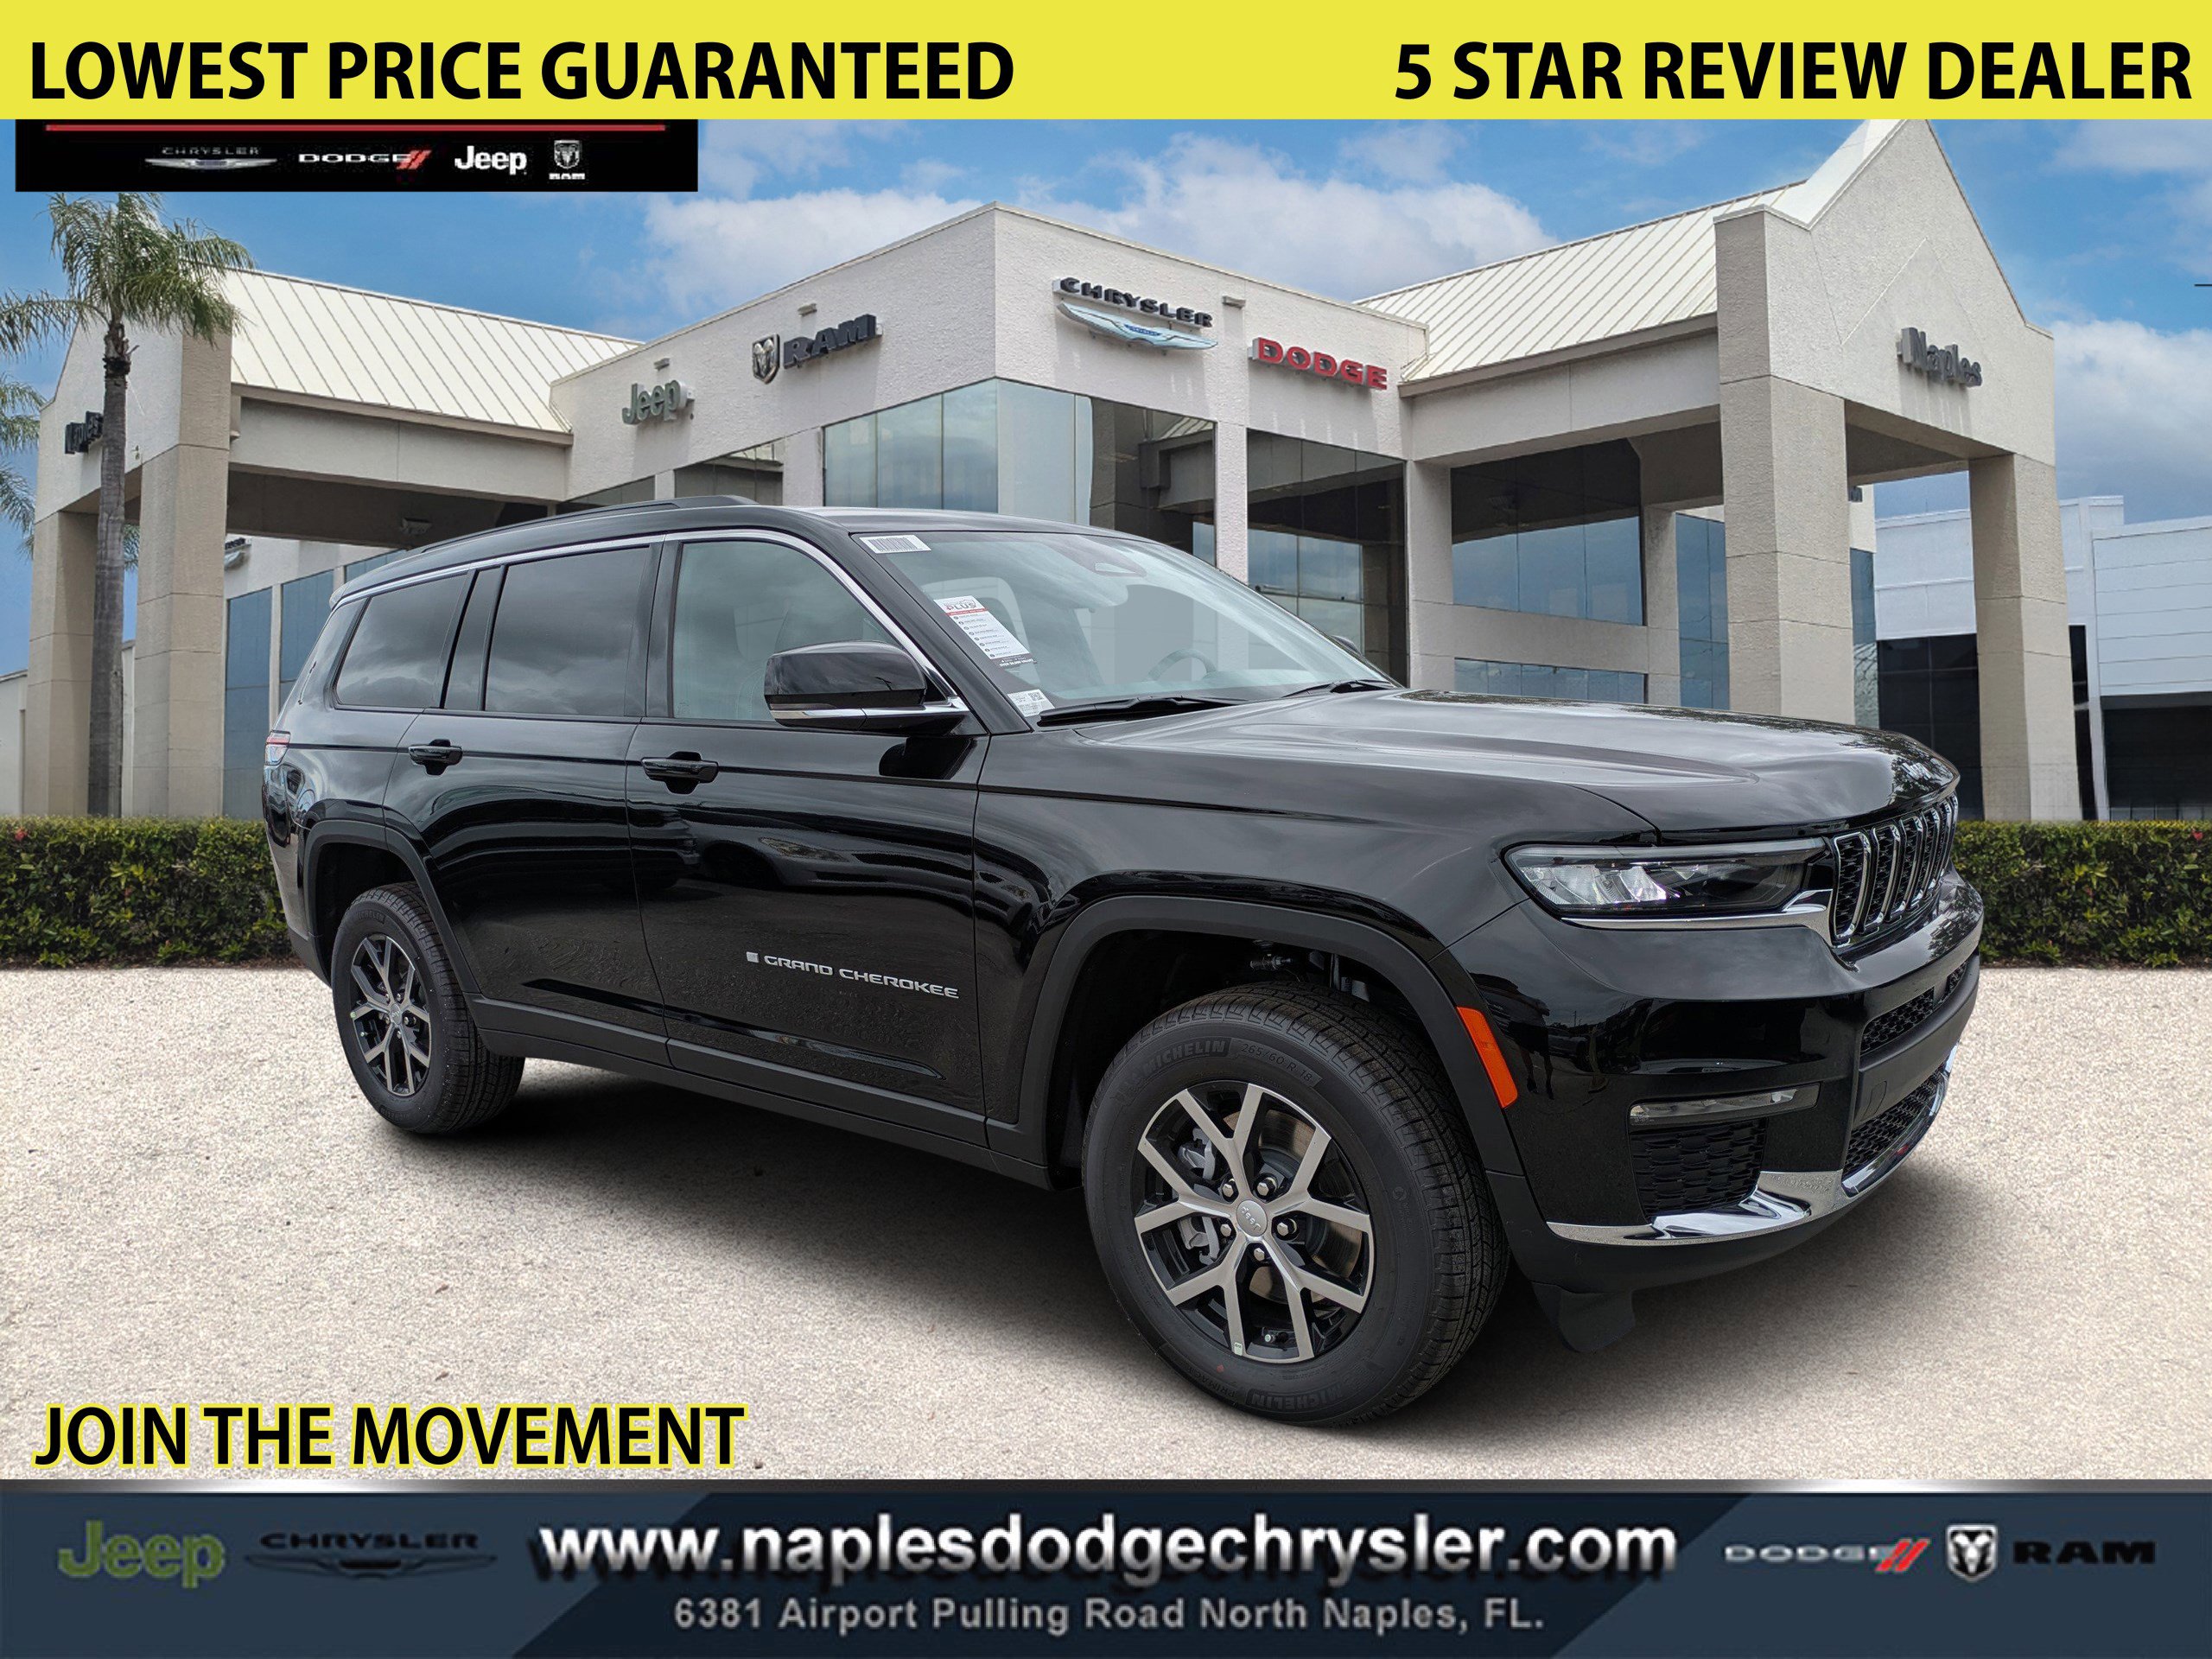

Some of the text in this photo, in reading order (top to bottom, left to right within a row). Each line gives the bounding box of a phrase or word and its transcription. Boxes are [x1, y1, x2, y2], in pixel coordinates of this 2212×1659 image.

[1059, 276, 1214, 327] CHRYSLER
[783, 314, 878, 370] RAM
[1253, 337, 1388, 391] DODGE
[1899, 327, 1983, 387] Naples
[621, 379, 683, 425] Jeep
[763, 955, 960, 1000] GRAND CHEROKEE
[1142, 1039, 1227, 1077] MICHELIN
[1241, 1043, 1286, 1065] 265/60
[1300, 1069, 1314, 1082] 18
